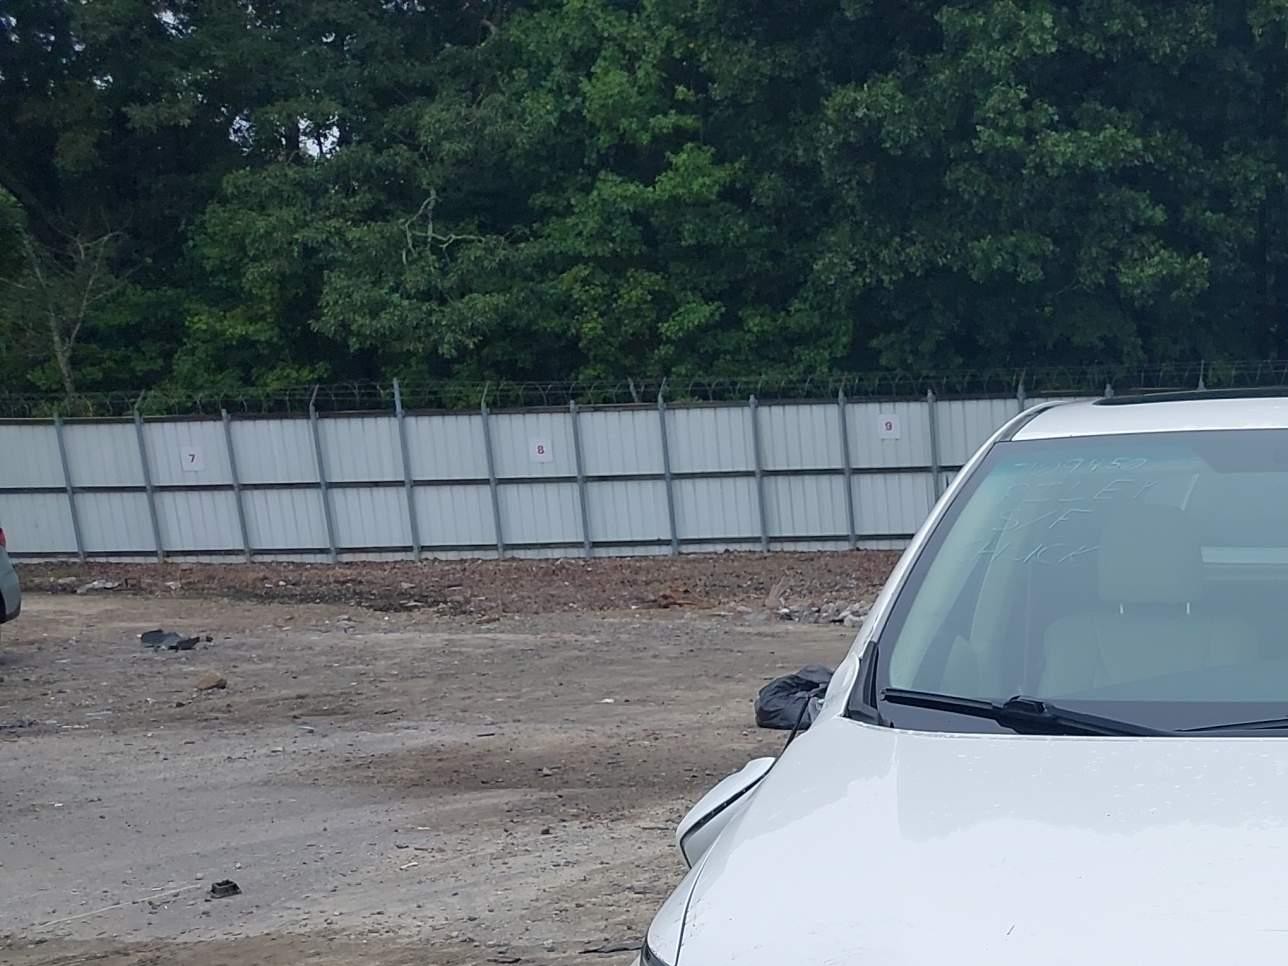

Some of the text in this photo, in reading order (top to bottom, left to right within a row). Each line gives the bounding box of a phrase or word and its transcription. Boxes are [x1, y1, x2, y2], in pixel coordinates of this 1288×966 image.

[885, 421, 893, 431] 9
[537, 445, 545, 455] 8
[188, 454, 196, 464] 7
